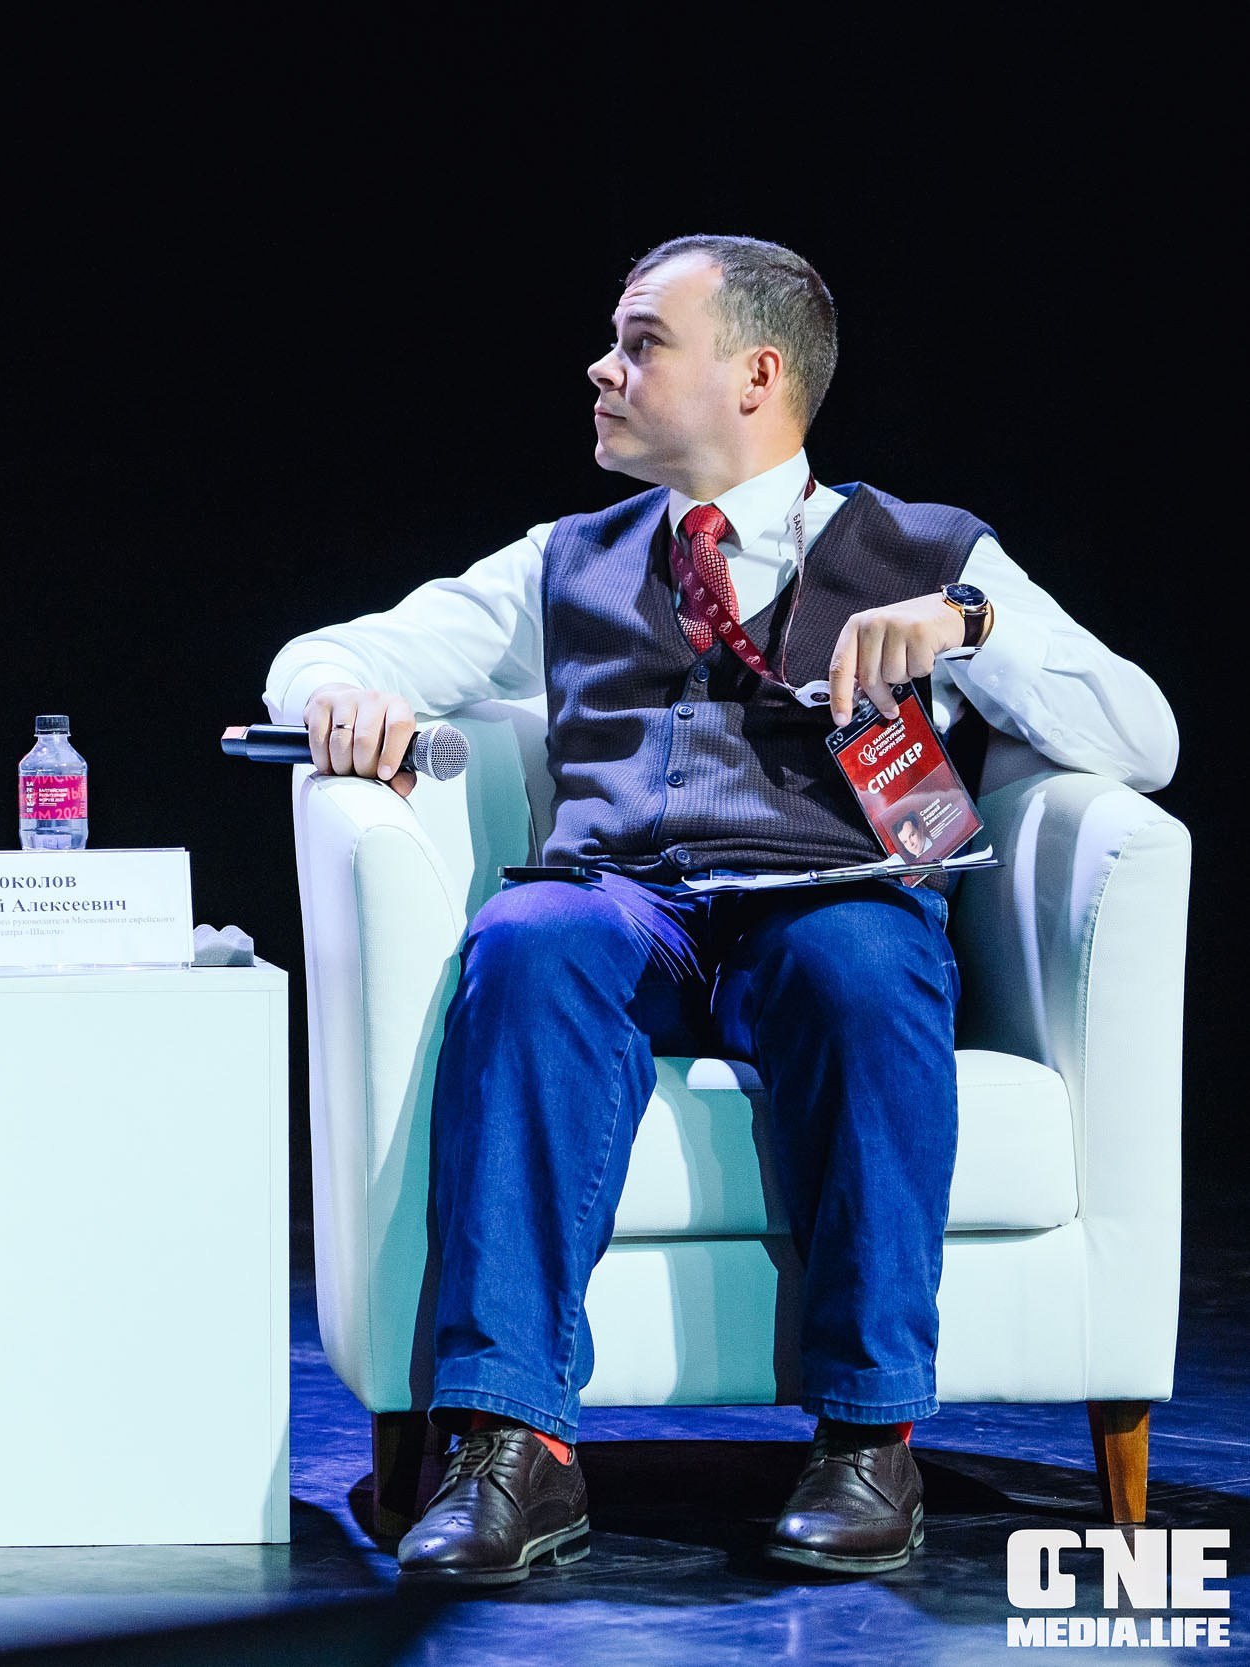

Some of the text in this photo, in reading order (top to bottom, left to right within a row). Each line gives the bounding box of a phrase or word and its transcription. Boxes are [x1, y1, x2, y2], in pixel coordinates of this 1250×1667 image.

[867, 742, 924, 795] СПИКЕР
[12, 898, 127, 914] Алексеевич
[72, 915, 128, 926] Московского
[129, 914, 176, 926] еврейского
